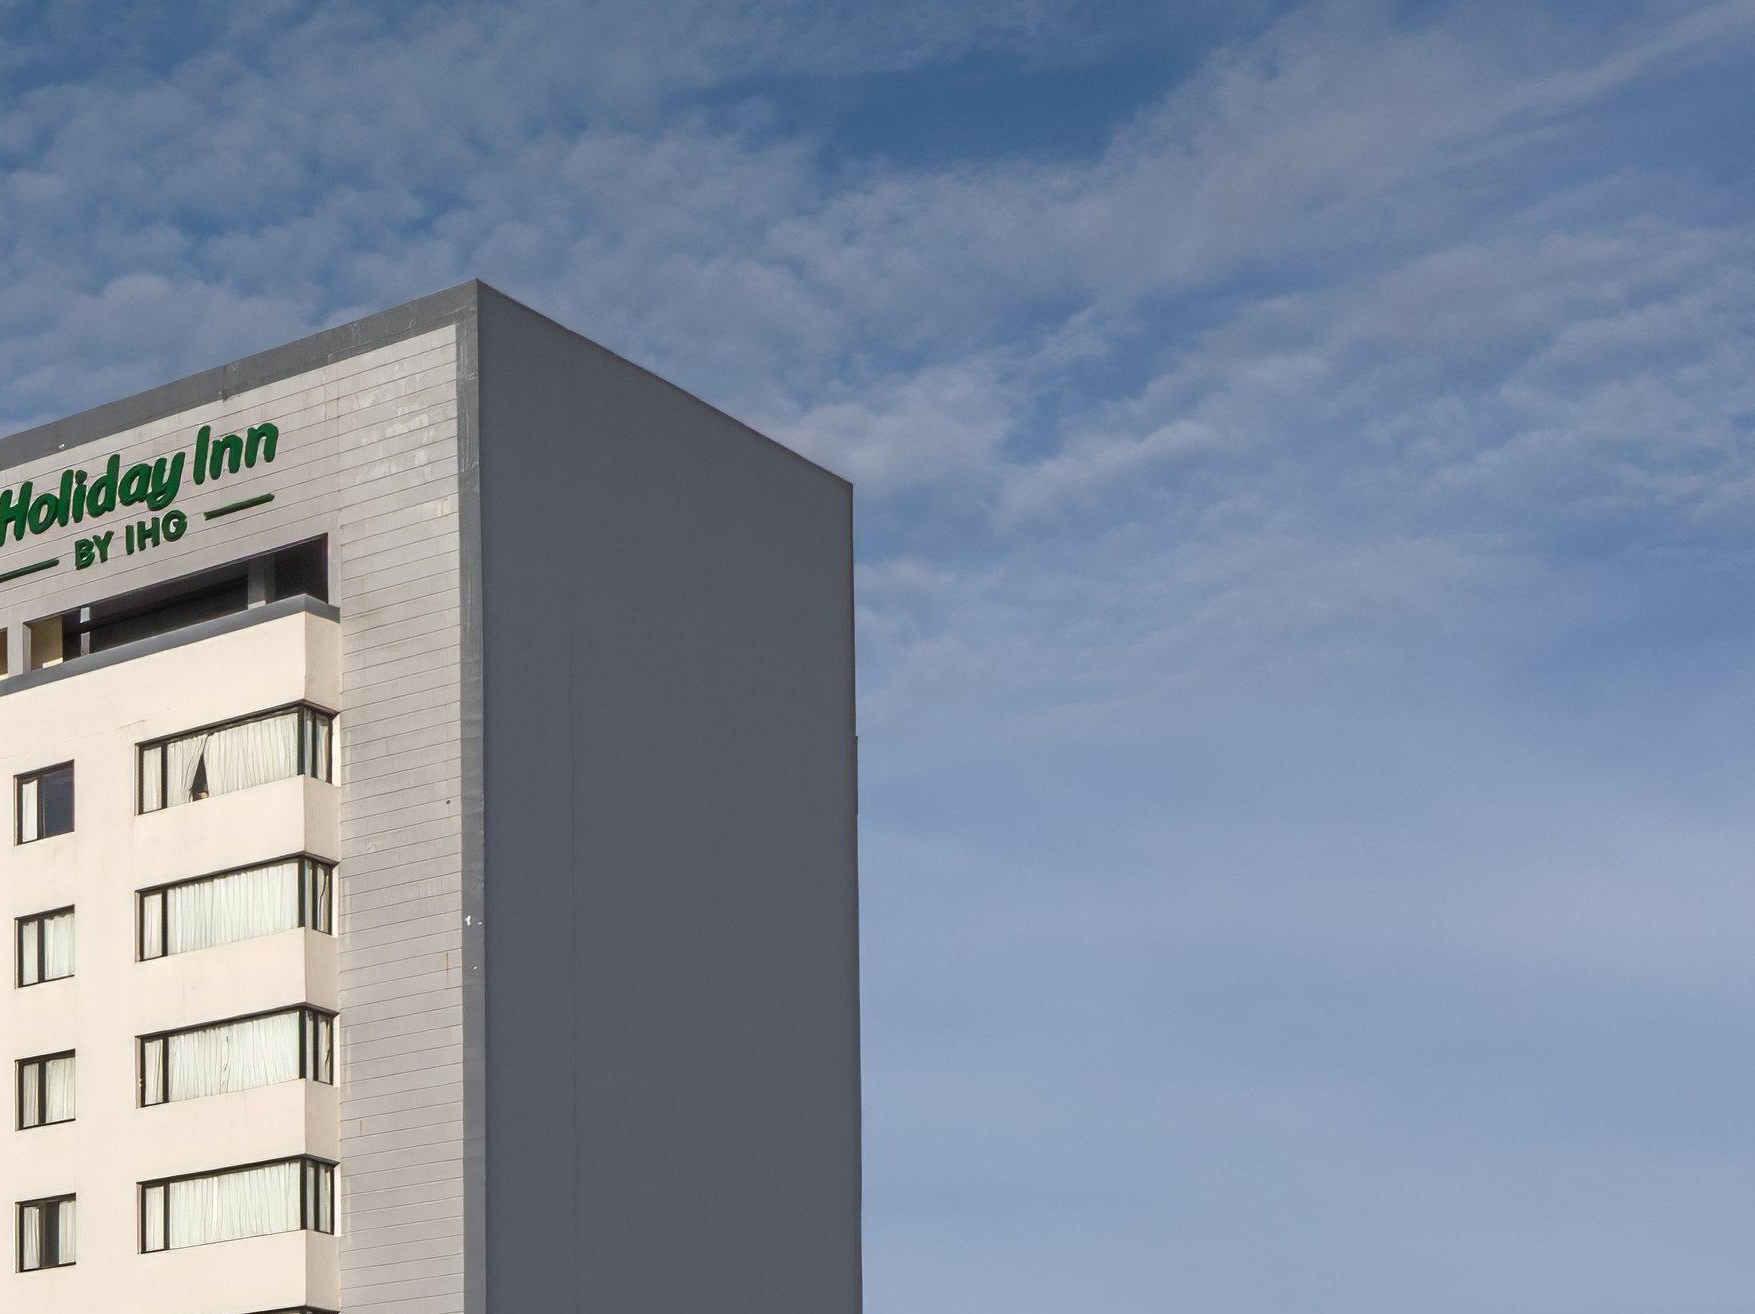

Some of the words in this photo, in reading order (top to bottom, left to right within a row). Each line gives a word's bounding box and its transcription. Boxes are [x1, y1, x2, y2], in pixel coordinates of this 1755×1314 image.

[193, 422, 280, 485] Inn
[75, 531, 113, 570] BY
[125, 509, 189, 556] IHG
